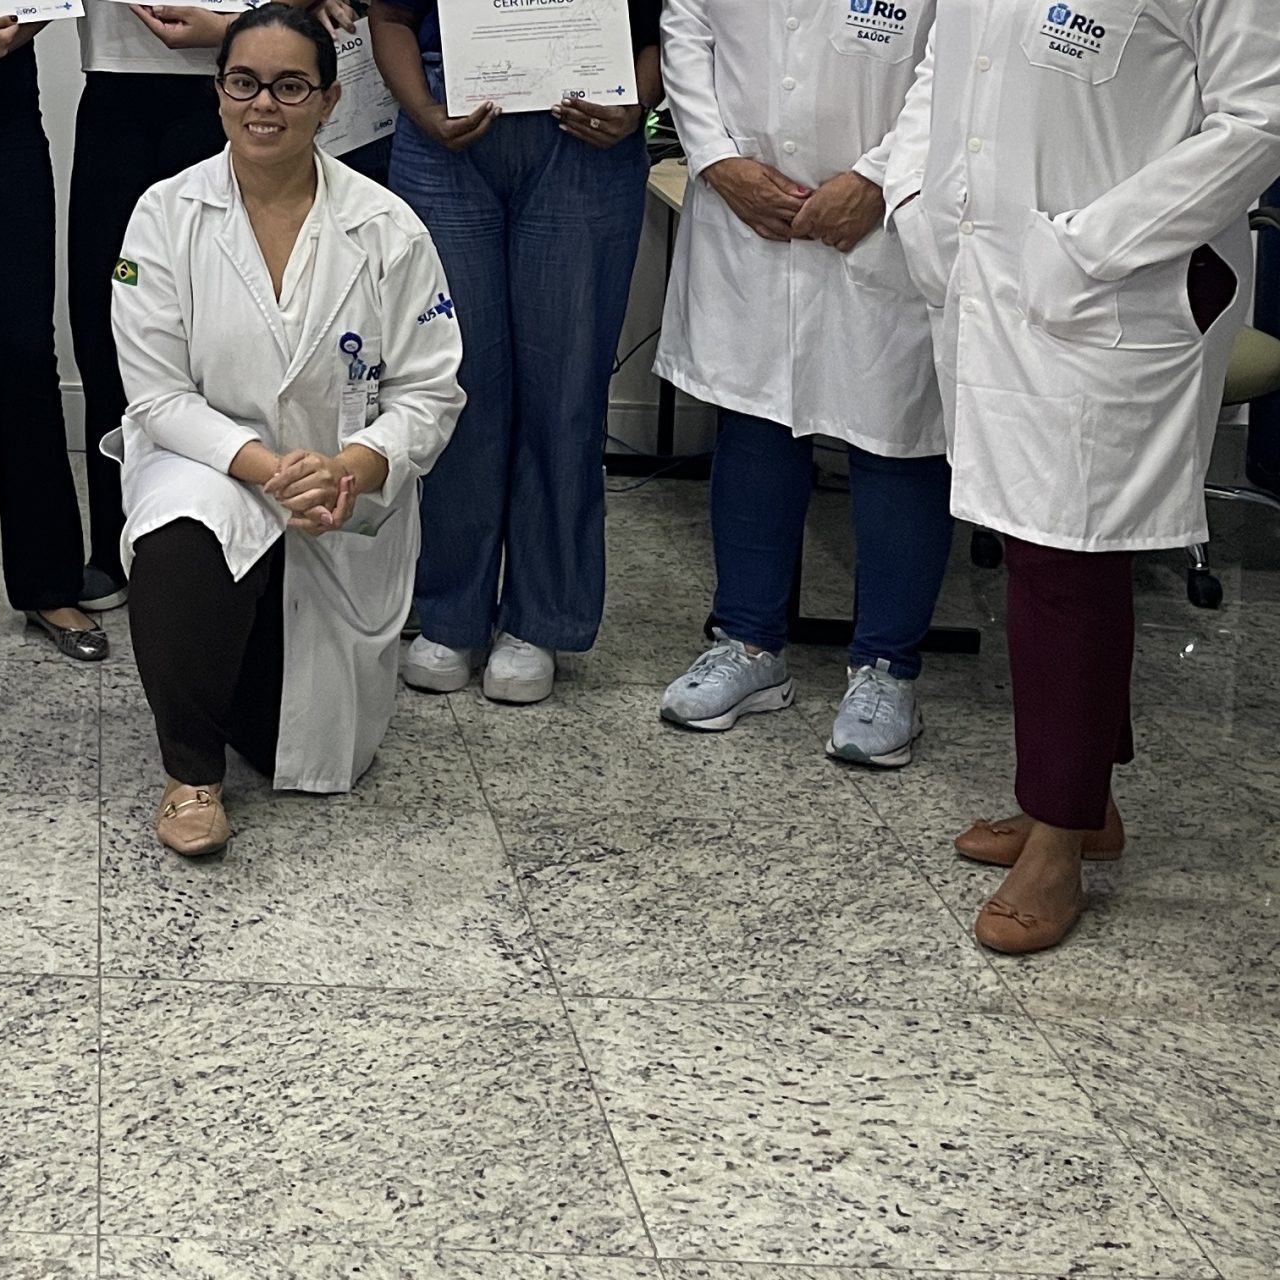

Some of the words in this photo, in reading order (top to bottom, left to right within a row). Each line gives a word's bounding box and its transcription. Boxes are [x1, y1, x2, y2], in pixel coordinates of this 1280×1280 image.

[873, 0, 907, 21] Rio
[847, 14, 904, 30] PREFEITURA
[1069, 13, 1106, 39] Rio
[857, 30, 891, 44] SAÚDE
[1048, 41, 1084, 59] SAÚDE
[417, 308, 437, 326] SUS
